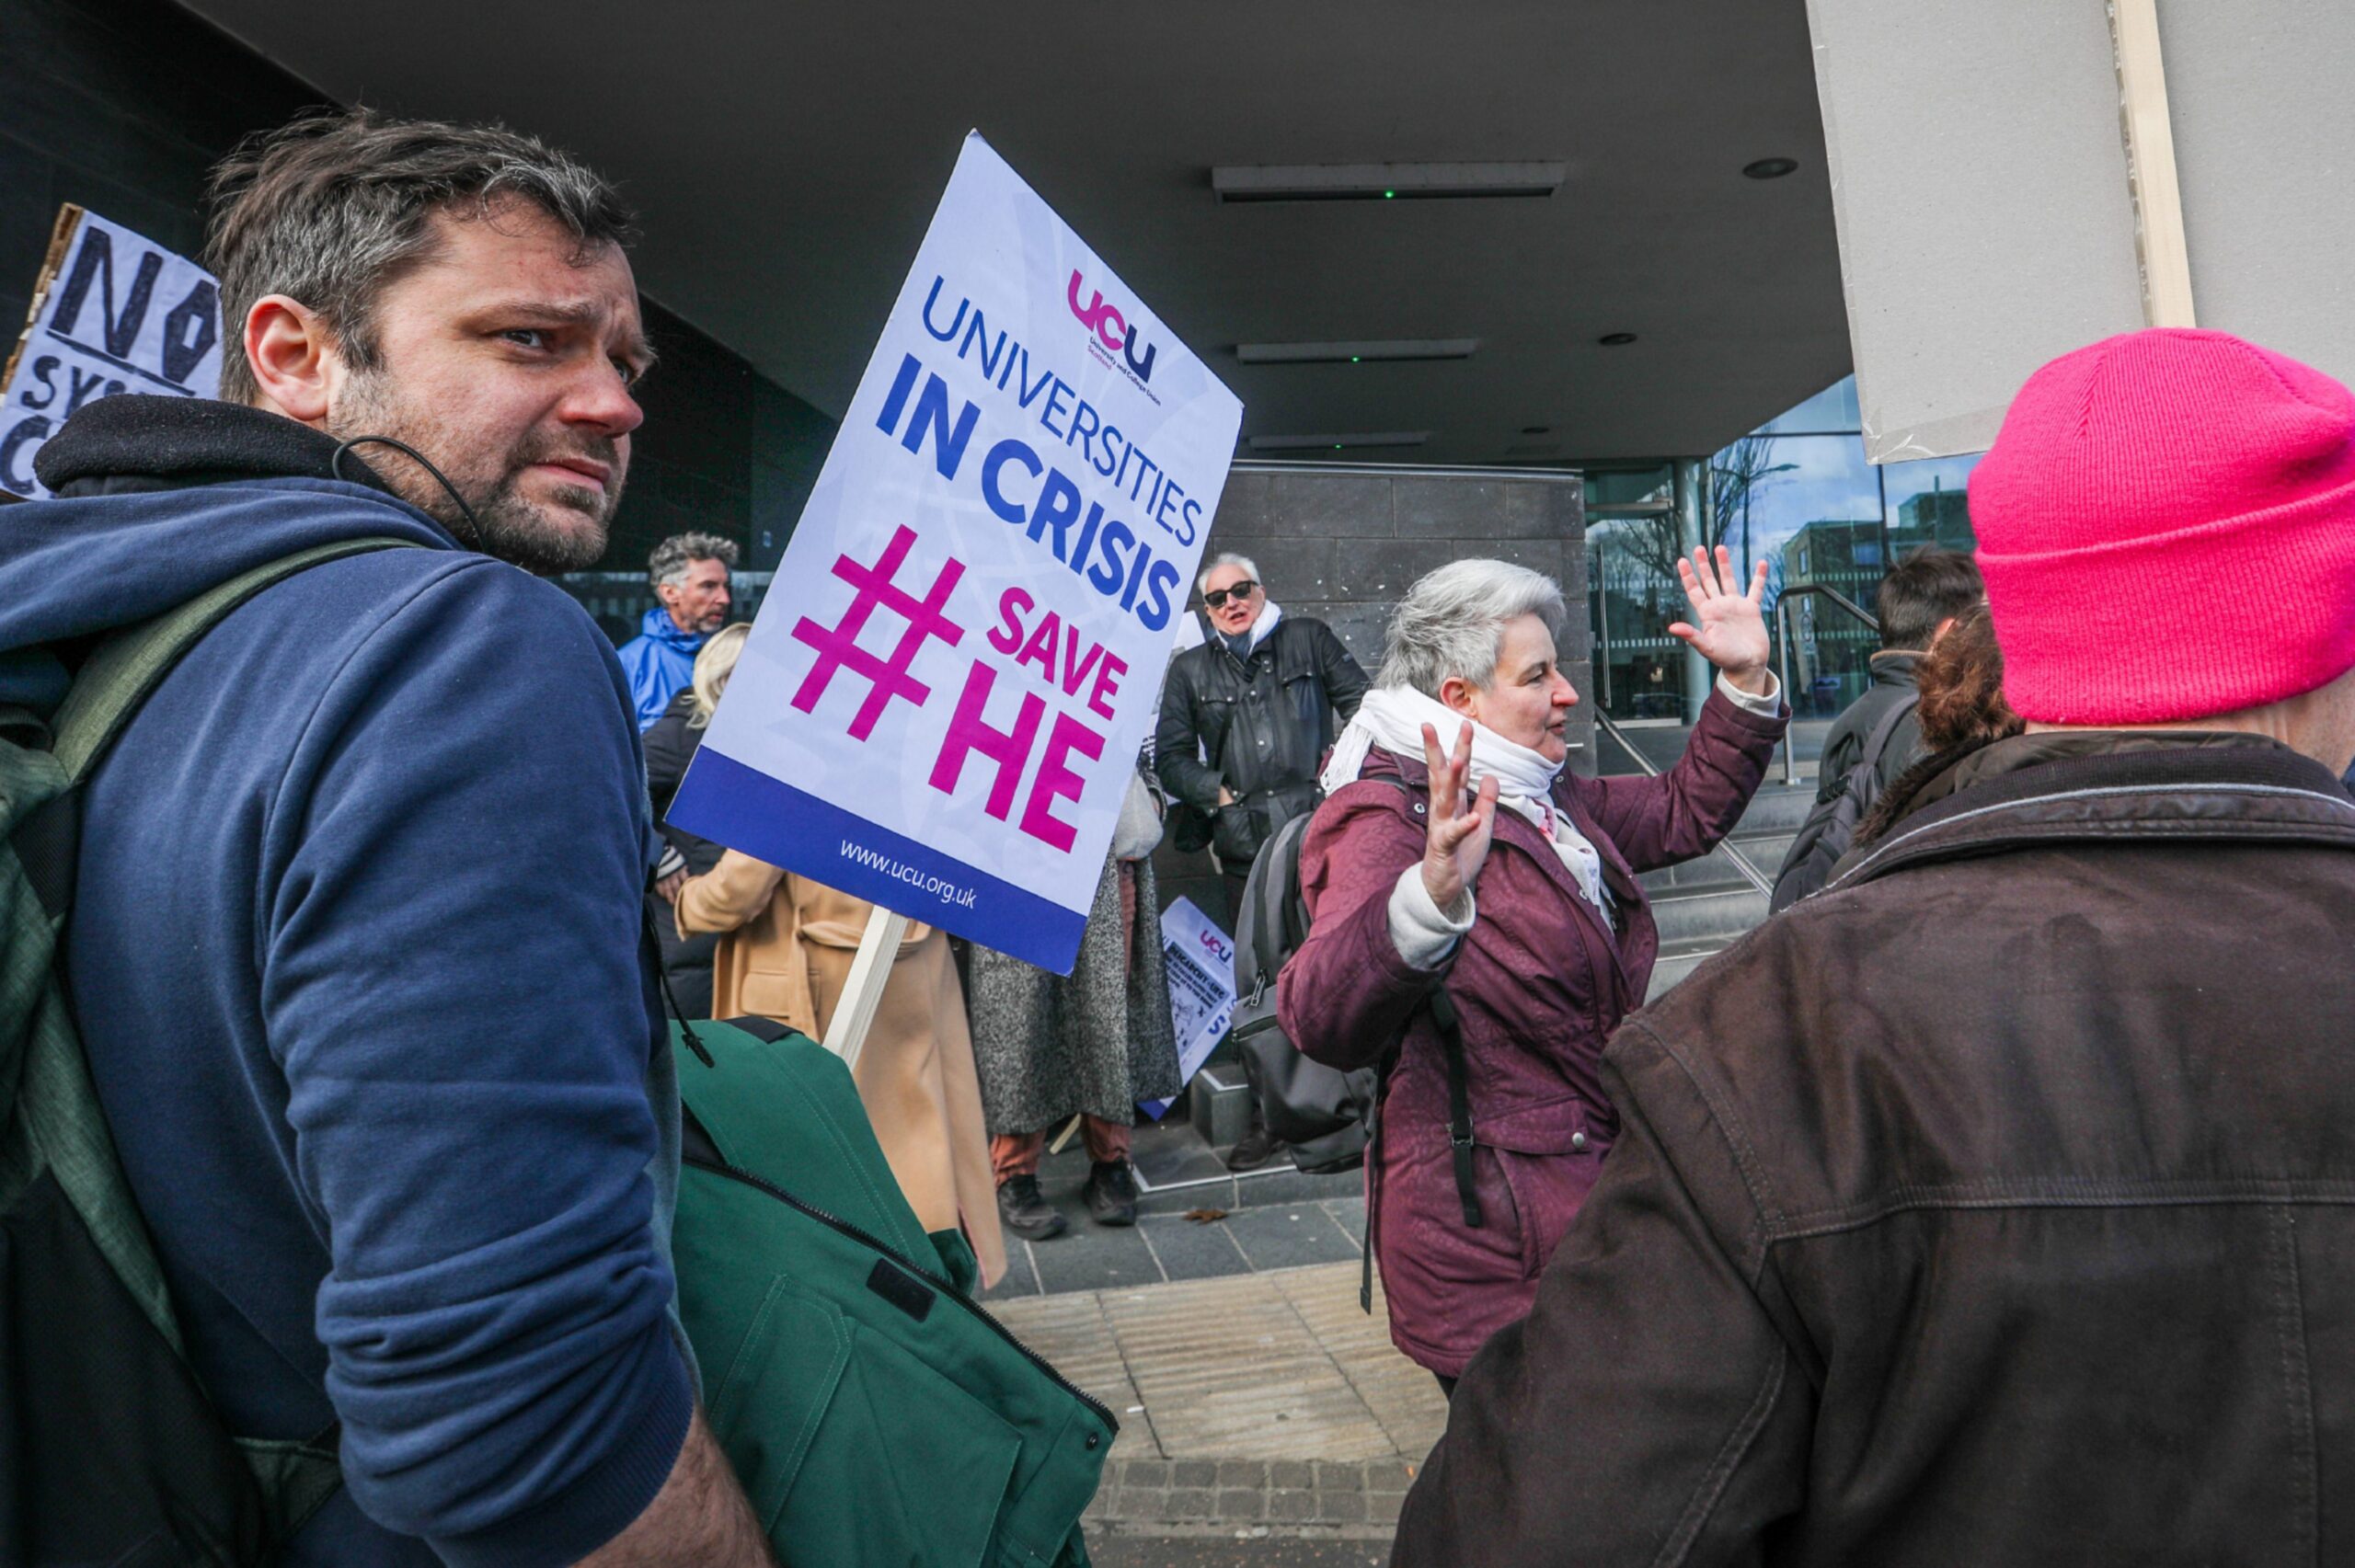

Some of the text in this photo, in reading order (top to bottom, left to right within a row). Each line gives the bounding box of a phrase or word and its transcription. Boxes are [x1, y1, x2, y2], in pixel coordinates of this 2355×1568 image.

[49, 225, 217, 384] NO
[874, 351, 1183, 634] IN CRISIS
[921, 274, 1203, 549] UNIVERSITIES
[928, 658, 1106, 854] HE
[840, 839, 977, 910] www.ucu.org.uk
